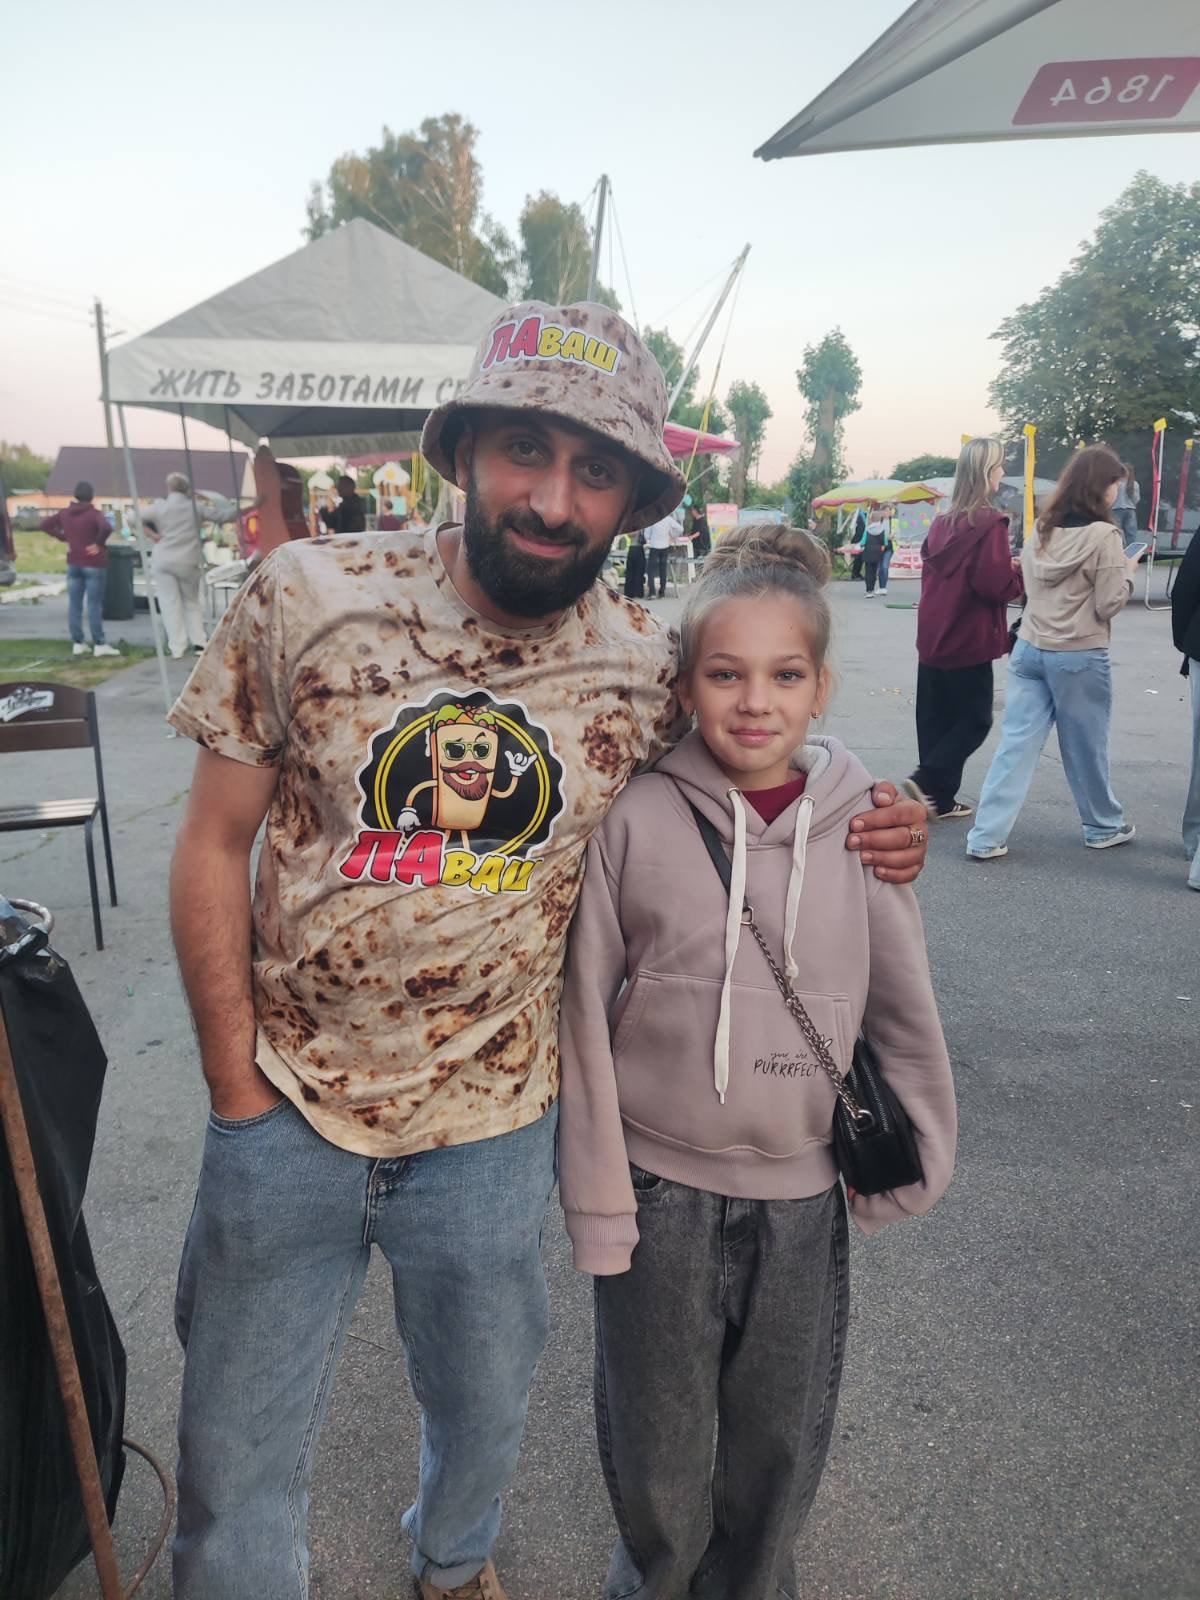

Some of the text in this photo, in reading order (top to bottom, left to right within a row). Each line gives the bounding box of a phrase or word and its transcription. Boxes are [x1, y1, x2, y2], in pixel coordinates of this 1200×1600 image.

[482, 316, 619, 373] ЛАВАШ
[149, 368, 242, 398] ЖИТЬ
[255, 371, 424, 404] ЗАБОТАМИ
[753, 1058, 819, 1078] PURRRFECT
